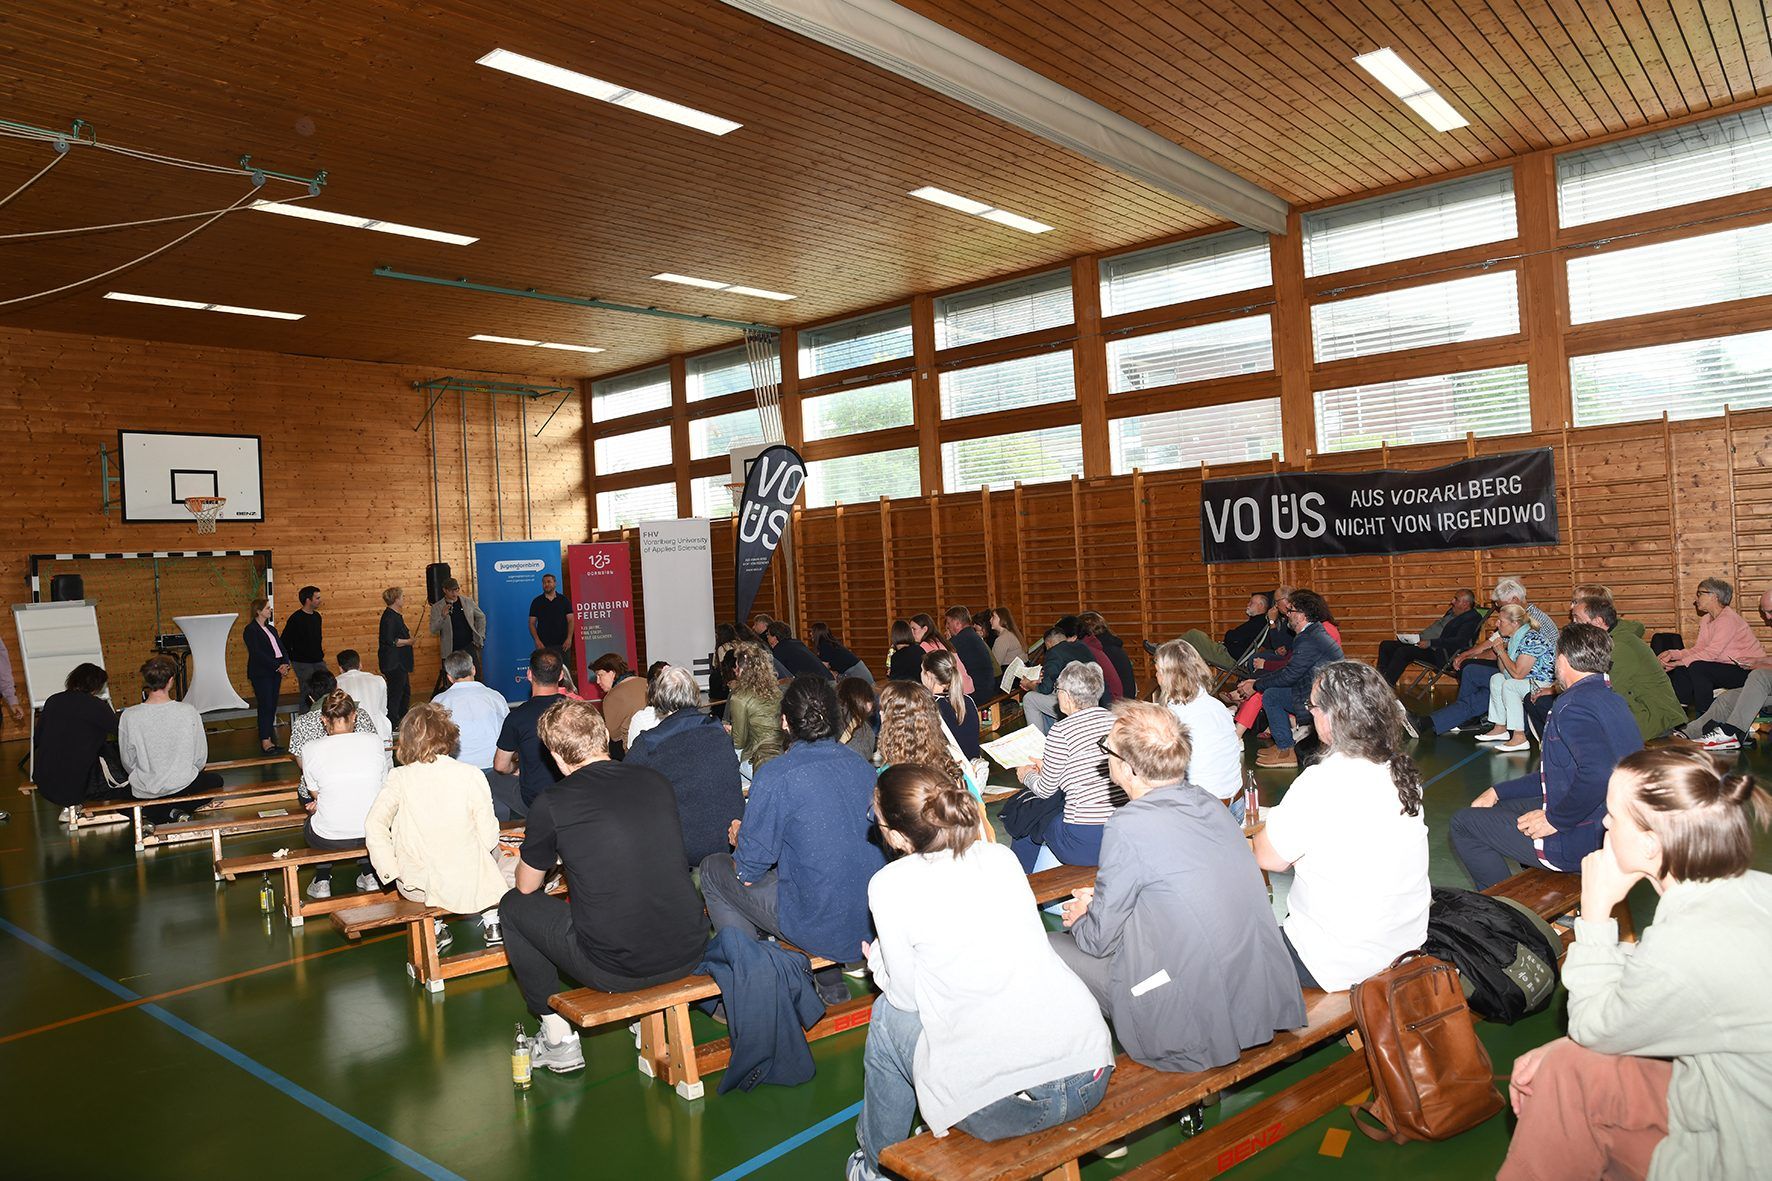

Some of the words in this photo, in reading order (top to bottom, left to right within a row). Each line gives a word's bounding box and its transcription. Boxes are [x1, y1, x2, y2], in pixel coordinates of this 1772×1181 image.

[758, 456, 805, 505] VO
[1350, 489, 1385, 508] AUS
[1390, 475, 1522, 506] VORARLBERG
[740, 500, 789, 550] ÜS
[1204, 497, 1261, 543] VO
[1271, 491, 1326, 539] ÜS
[1335, 517, 1386, 537] NICHT
[1391, 514, 1432, 534] VON
[1437, 502, 1546, 532] IRGENDWO
[576, 600, 629, 611] DORNBIRN
[577, 610, 612, 620] FEIERT
[1217, 1122, 1283, 1171] BENZ
